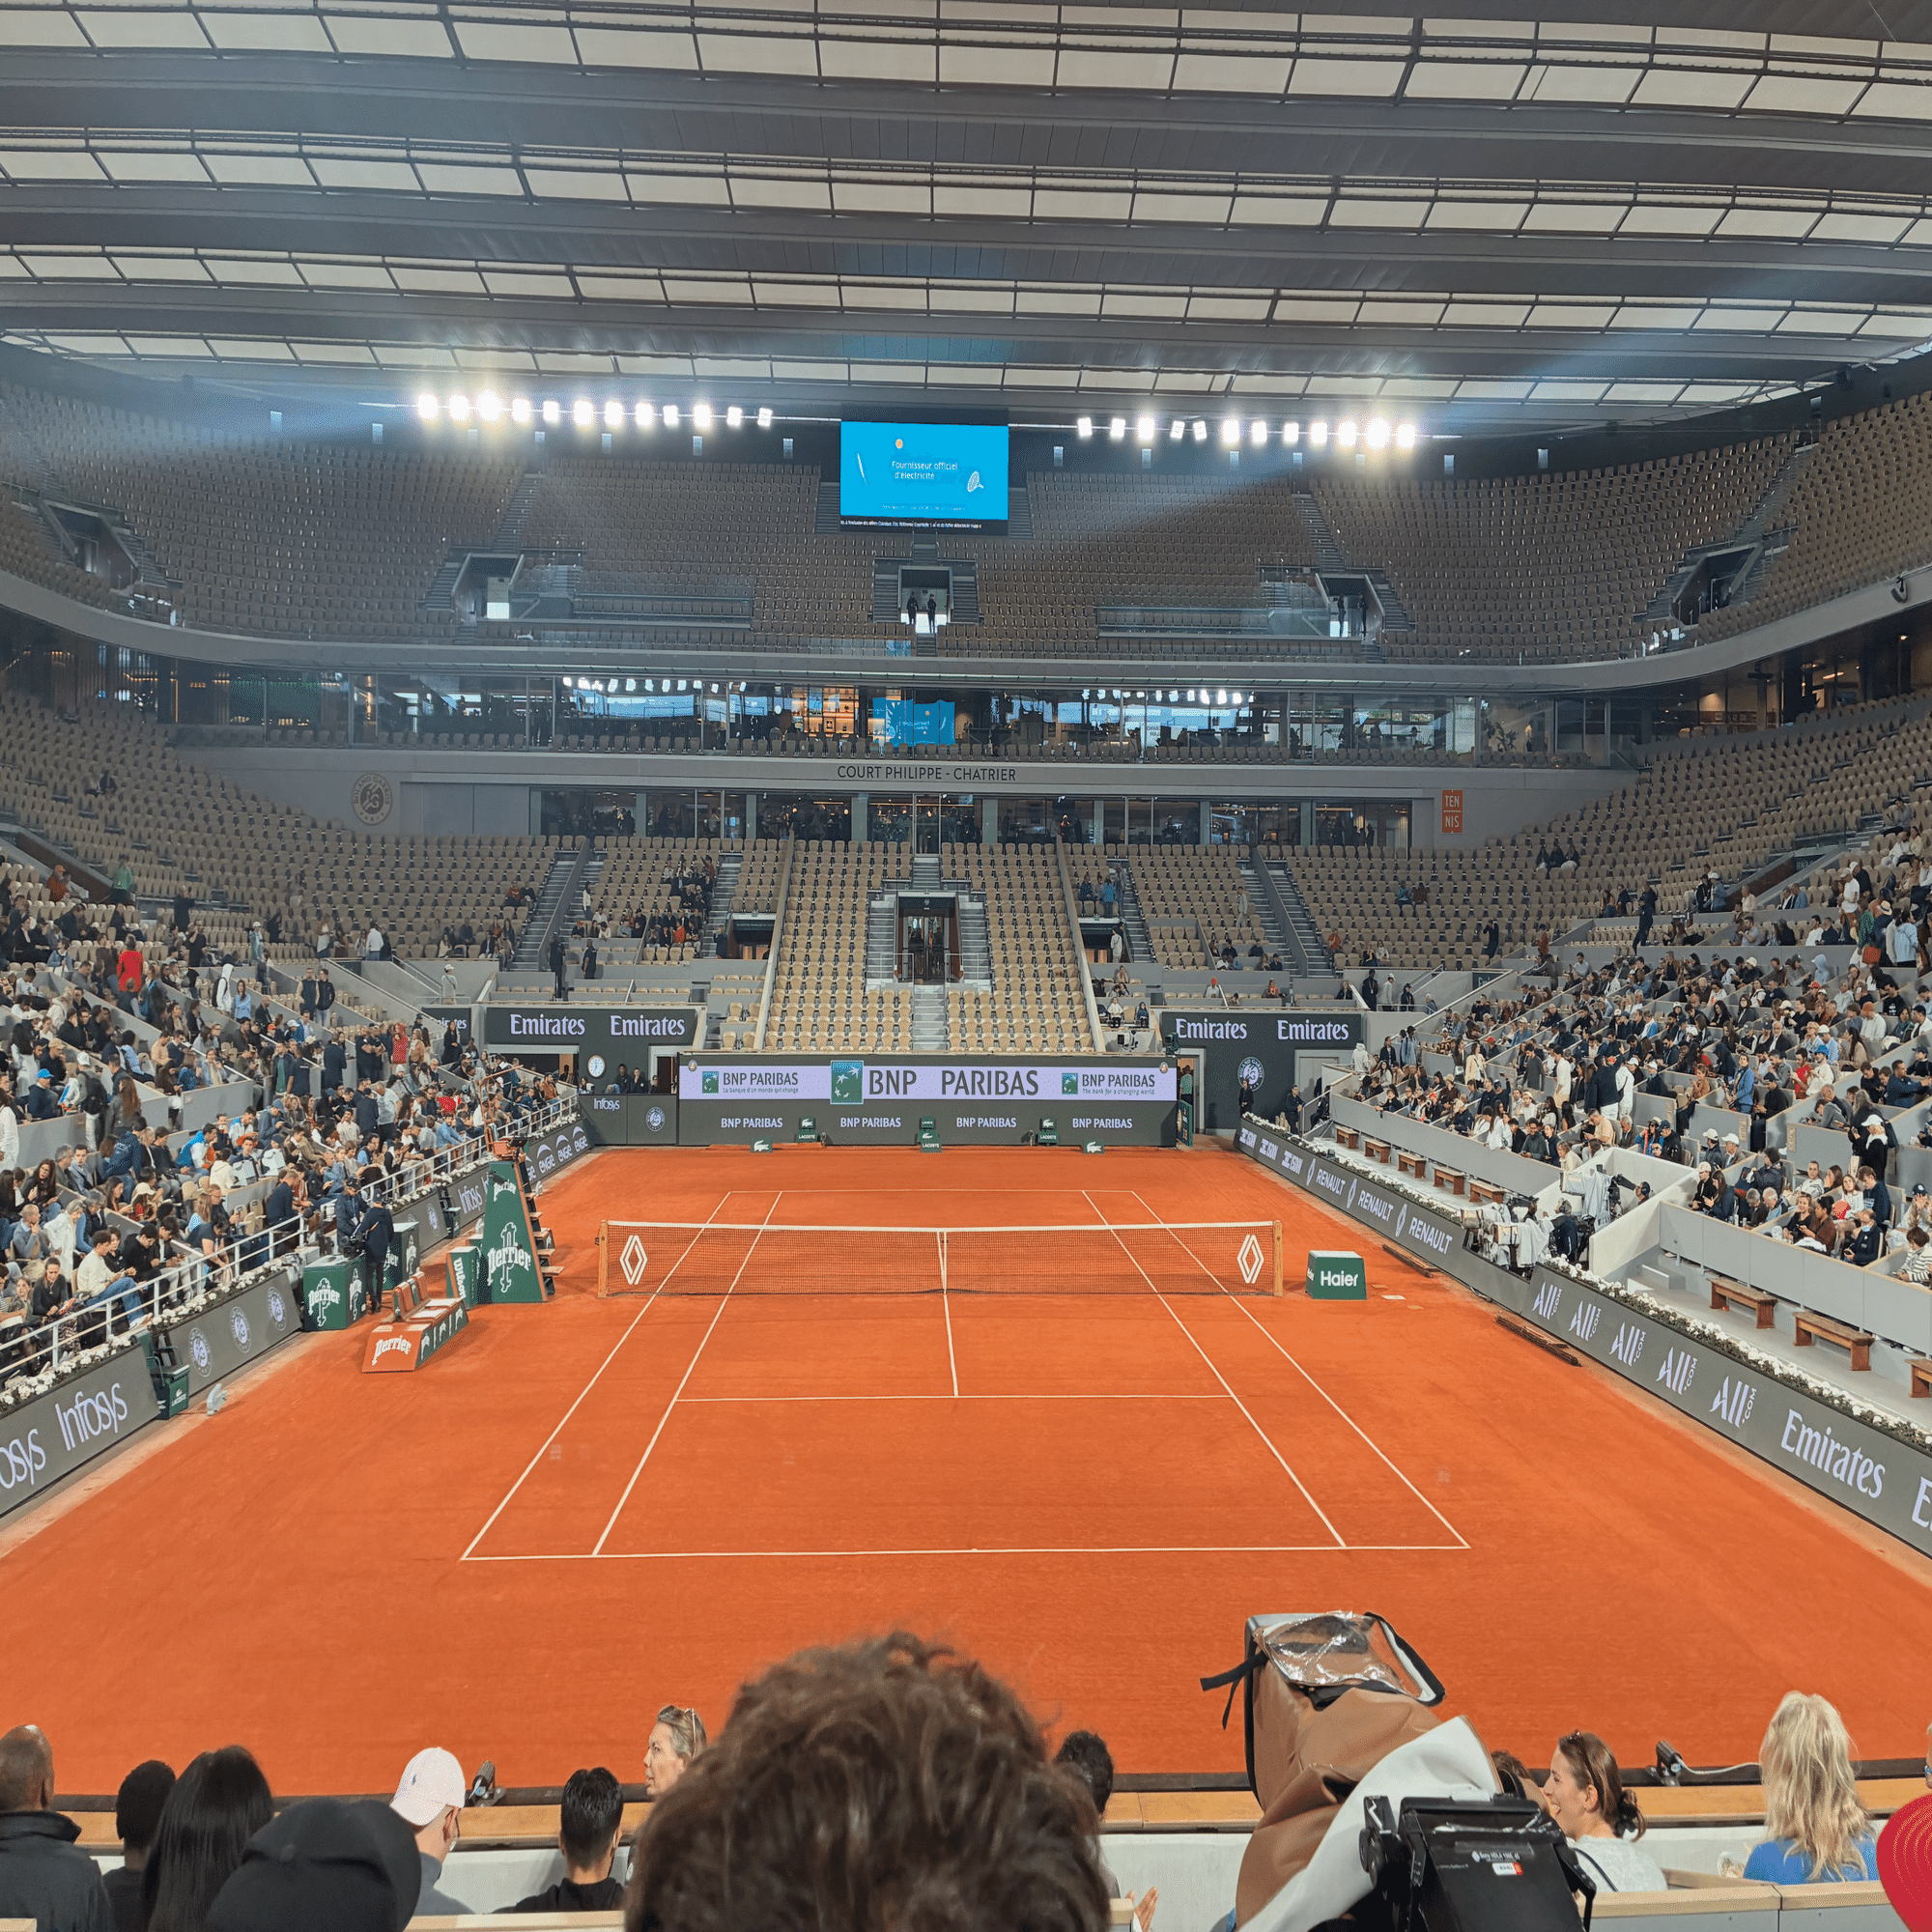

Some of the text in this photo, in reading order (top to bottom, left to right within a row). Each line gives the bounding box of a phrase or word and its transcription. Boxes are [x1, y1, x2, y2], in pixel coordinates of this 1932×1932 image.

[892, 461, 958, 470] Fournisseur officiel
[895, 471, 935, 480] d'électricité
[838, 765, 881, 779] COURT
[886, 766, 942, 780] PHILIPPE
[953, 768, 1016, 781] CHATRIER
[1445, 795, 1460, 809] TEN
[1445, 815, 1460, 828] NIS
[510, 1013, 685, 1037] Emirates Emirates
[1176, 1018, 1350, 1040] Emirates Emirates
[724, 1072, 799, 1086] BNP PARIBAS
[869, 1069, 1038, 1095] BNP PARIBAS
[1082, 1074, 1155, 1088] BNP PARIBAS
[593, 1097, 620, 1112] Infosys
[721, 1118, 783, 1128] BNP PARIBAS
[840, 1118, 901, 1127] BNP PARIBAS
[956, 1118, 1017, 1127] BNP PARIBAS
[1072, 1118, 1133, 1128] BNP PARIBAS
[1239, 1127, 1453, 1255] IBM IBM IBM RENAULT RENAULT RENAULT
[458, 1185, 483, 1214] Infosys
[453, 1257, 467, 1299] Wilson
[1321, 1270, 1359, 1287] Haier
[55, 1382, 128, 1452] Infosys
[1780, 1408, 1886, 1498] Emirates
